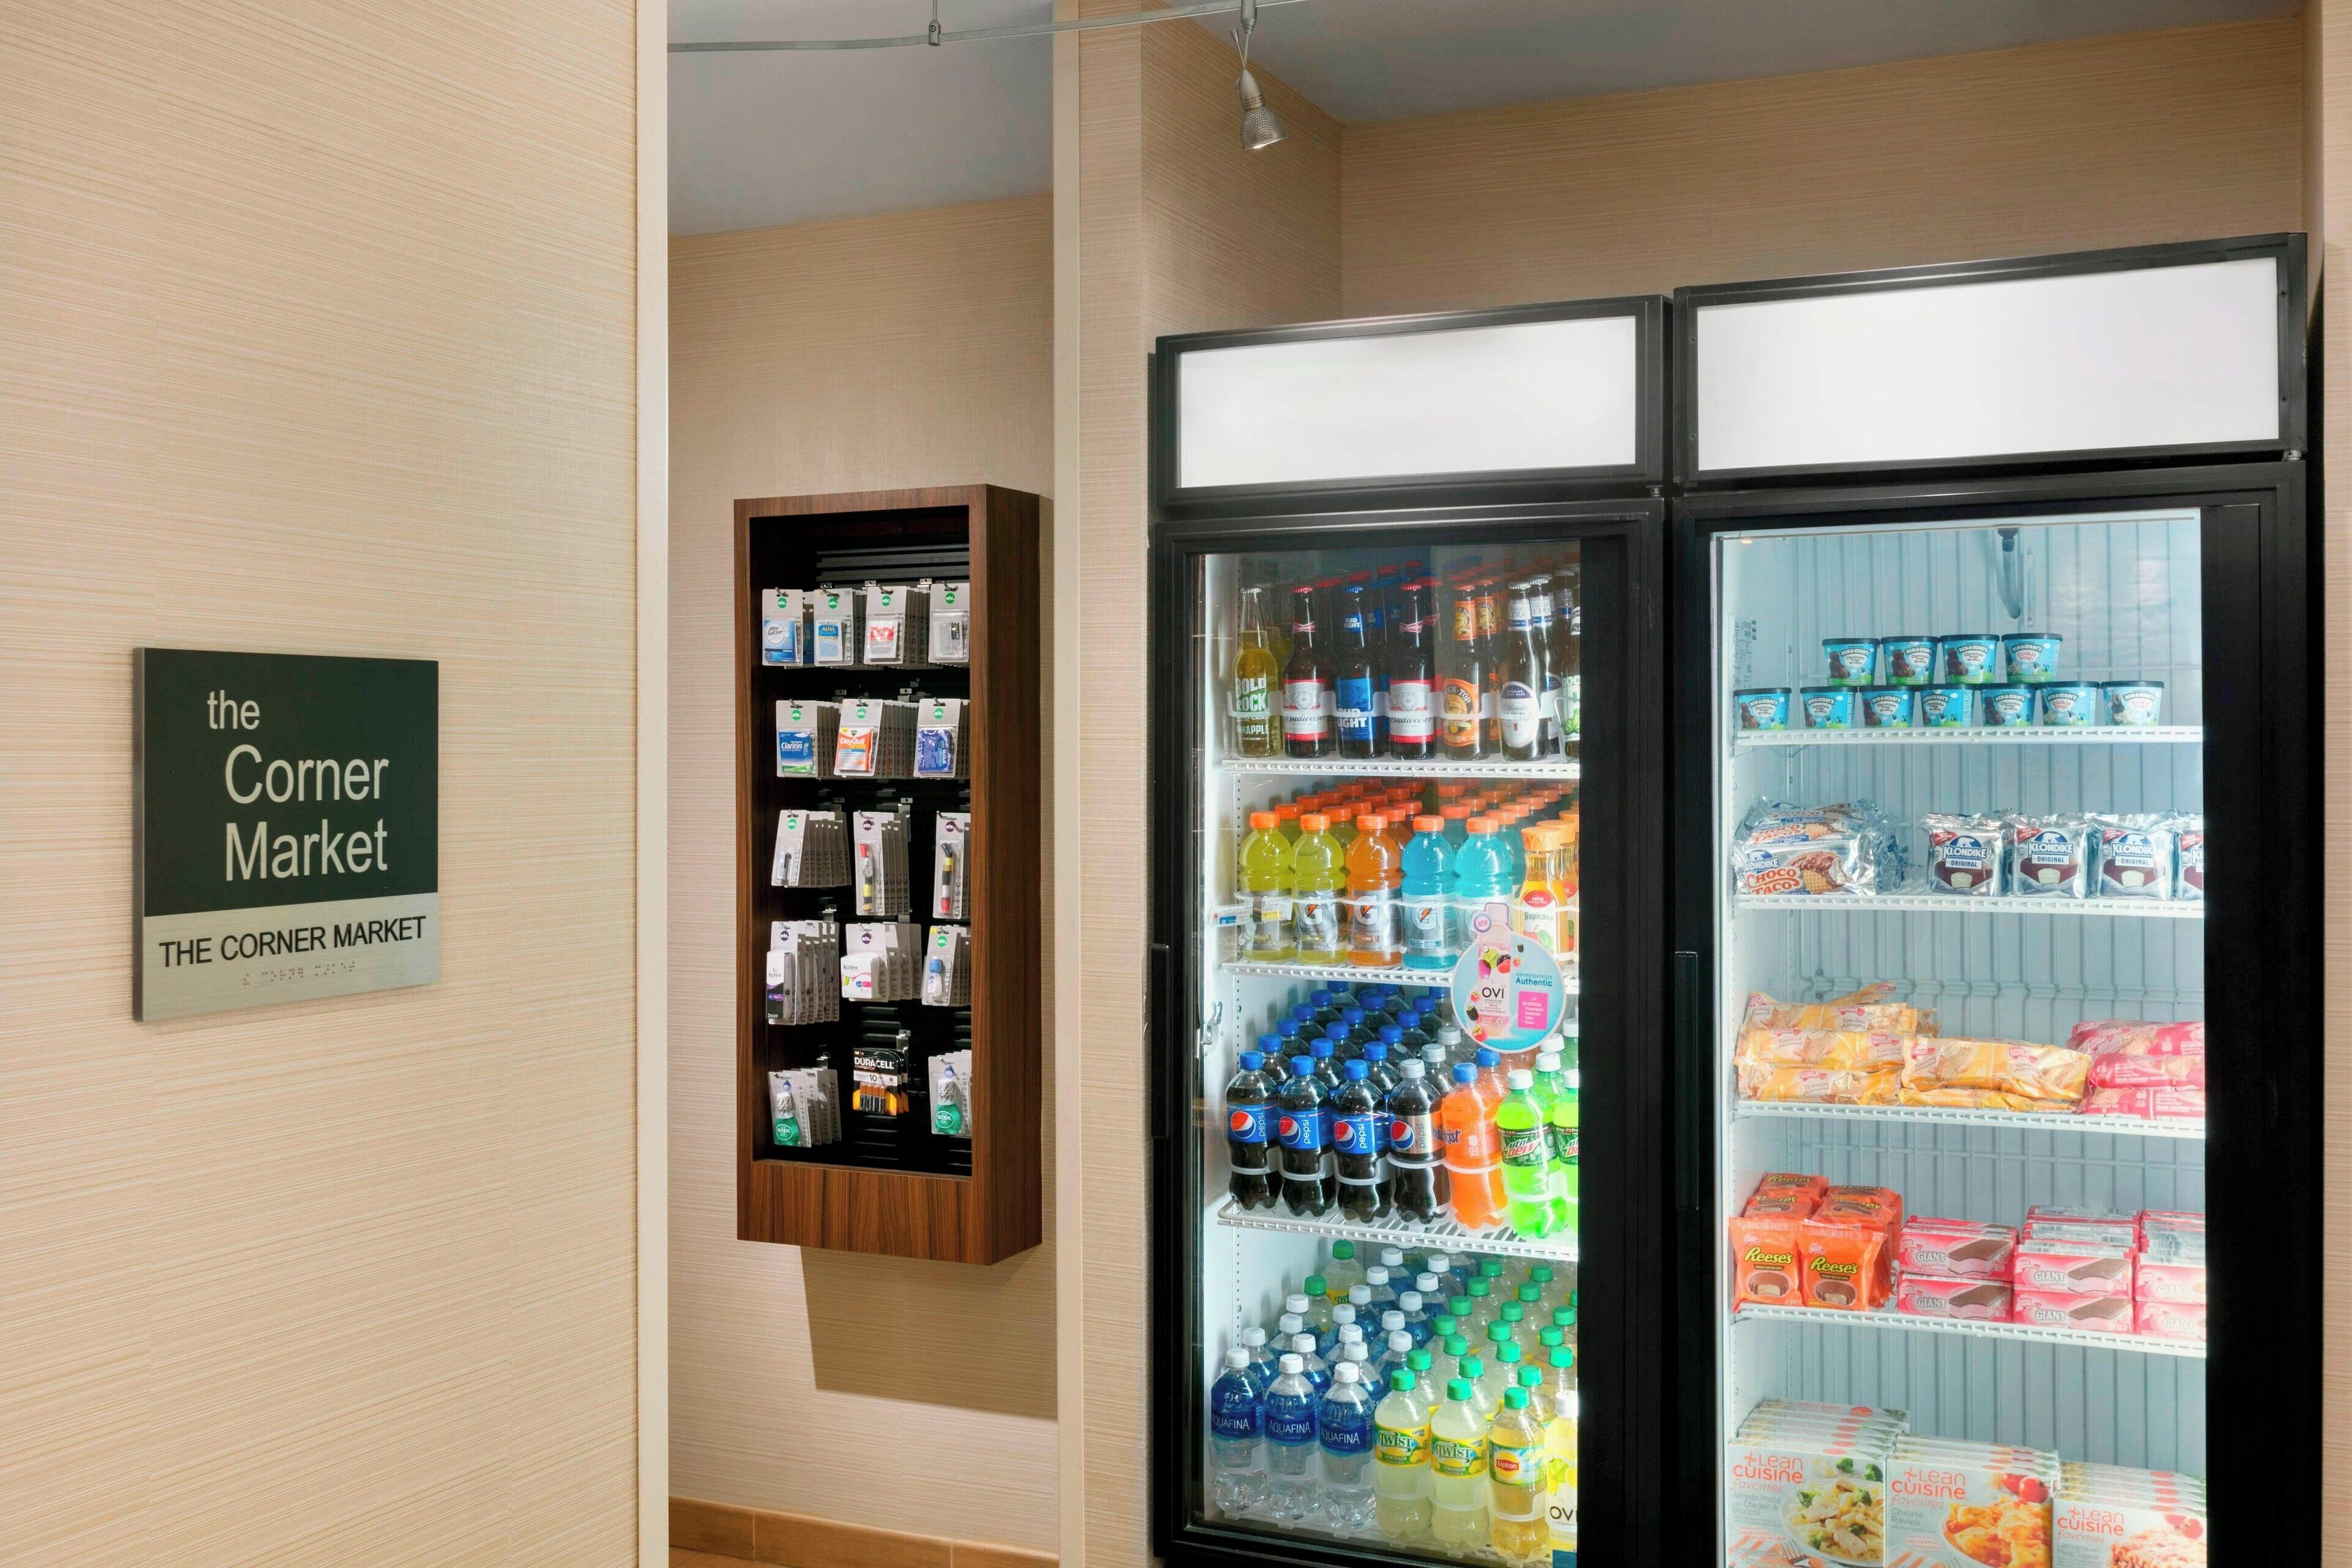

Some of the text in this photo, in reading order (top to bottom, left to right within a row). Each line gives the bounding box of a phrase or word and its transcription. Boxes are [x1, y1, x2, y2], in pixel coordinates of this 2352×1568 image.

[1235, 678, 1266, 697] BOLD
[1236, 692, 1267, 712] ROCK
[208, 690, 260, 729] the
[840, 737, 865, 747] DayQuil
[225, 744, 389, 804] Corner
[226, 818, 387, 881] Market
[1943, 846, 1988, 859] KLONDIKE
[2028, 843, 2074, 856] KLONDIKE
[2113, 843, 2158, 857] KLONDIKE
[1747, 869, 1796, 887] CHOCO
[1752, 882, 1792, 894] TACO
[1524, 912, 1553, 921] Tropicana
[159, 916, 426, 967] THE CORNER MARKET
[1515, 978, 1553, 987] Authentic
[1482, 987, 1504, 999] OVI
[854, 1057, 894, 1069] DURACELL
[1257, 1112, 1265, 1137] pepsi
[1302, 1120, 1311, 1144] pepsi
[1357, 1123, 1368, 1149] pepsi
[1507, 1141, 1537, 1157] DEW
[1744, 1246, 1793, 1264] Reese's
[1916, 1251, 1947, 1262] GIANT
[1810, 1256, 1859, 1274] Reese's
[2034, 1271, 2065, 1281] GIANT
[2158, 1284, 2189, 1295] GIANT
[1917, 1297, 1947, 1308] GIANT
[2036, 1310, 2065, 1321] GIANT
[2163, 1319, 2195, 1329] GIANT
[1212, 1413, 1250, 1430] AQUAFINA
[1268, 1421, 1311, 1435] AQUAFINA
[1321, 1427, 1360, 1444] AQUAFINA
[1379, 1433, 1413, 1448] TWIST
[1436, 1444, 1472, 1459] TWIST
[1498, 1461, 1517, 1469] Lipton
[1758, 1452, 1803, 1471] Lean
[1919, 1469, 1966, 1487] Lean
[1730, 1478, 1783, 1493] favorites
[1733, 1491, 1781, 1504] Alfredo Pasta
[1890, 1494, 1944, 1509] favorites
[1732, 1507, 1761, 1516] Broccoli
[1744, 1500, 1771, 1510] Chicken
[1891, 1507, 1924, 1518] Cheese
[2082, 1508, 2125, 1524] Lean
[1891, 1515, 1920, 1526] Ravioli
[2056, 1530, 2106, 1544] favorites
[2057, 1543, 2089, 1551] Lasagna
[2057, 1548, 2098, 1559] Meat Sauce
